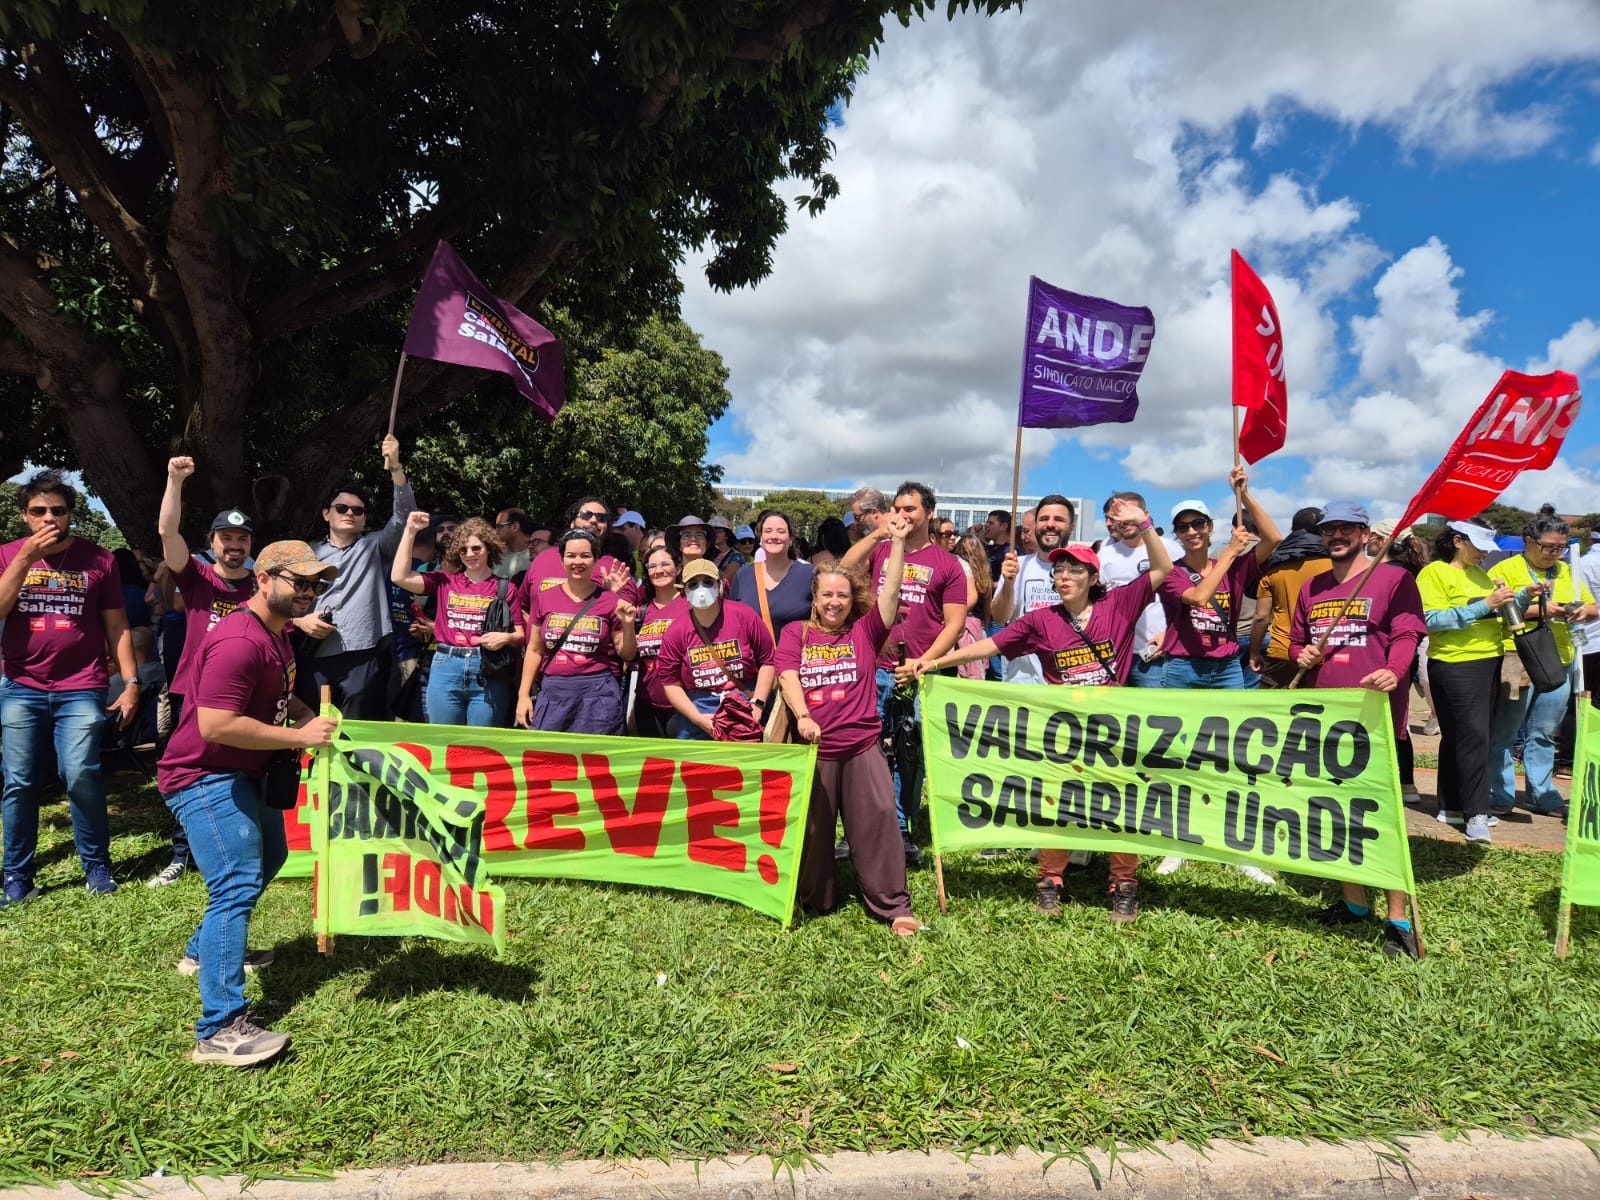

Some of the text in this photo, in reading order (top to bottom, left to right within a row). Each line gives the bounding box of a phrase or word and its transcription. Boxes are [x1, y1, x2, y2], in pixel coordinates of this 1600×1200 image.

[1034, 365, 1093, 389] SINDICATO
[18, 592, 85, 604] Campanha
[18, 601, 83, 615] Salarial
[448, 620, 482, 631] Salari
[1058, 649, 1114, 667] DISTRIAL
[800, 661, 857, 675] Campanha
[801, 671, 857, 688] Salarial
[945, 702, 1371, 786] VALORIZAÇÃO
[957, 773, 1379, 866] SALARIAL UnDF
